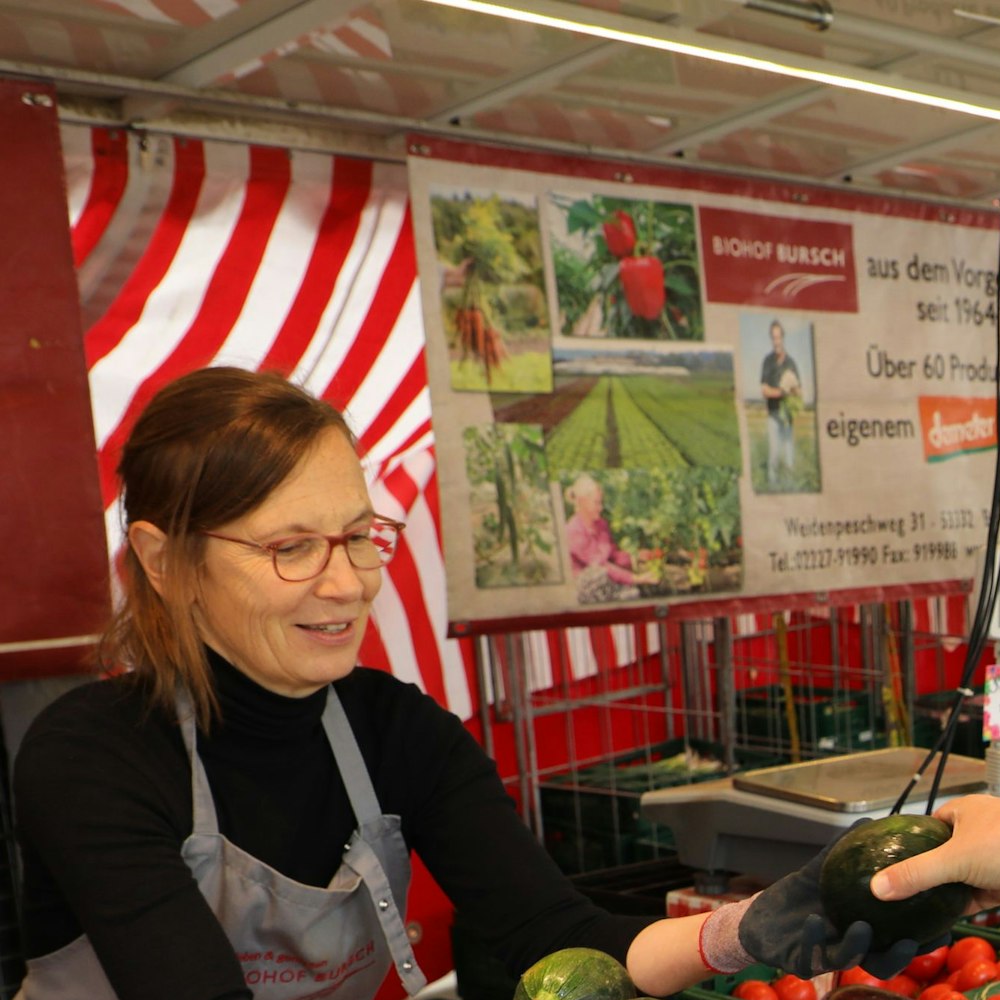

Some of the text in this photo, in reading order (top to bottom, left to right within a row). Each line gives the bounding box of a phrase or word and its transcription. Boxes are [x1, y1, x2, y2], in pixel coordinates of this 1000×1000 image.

[713, 236, 846, 267] BIOHOF BURSCH
[867, 256, 900, 280] aus
[907, 254, 949, 283] dem
[917, 297, 997, 327] seit 1964
[867, 344, 917, 380] Über
[923, 354, 945, 381] 60
[826, 410, 994, 449] eigenem demeter
[910, 511, 926, 532] 31
[245, 969, 307, 985] OHOF
